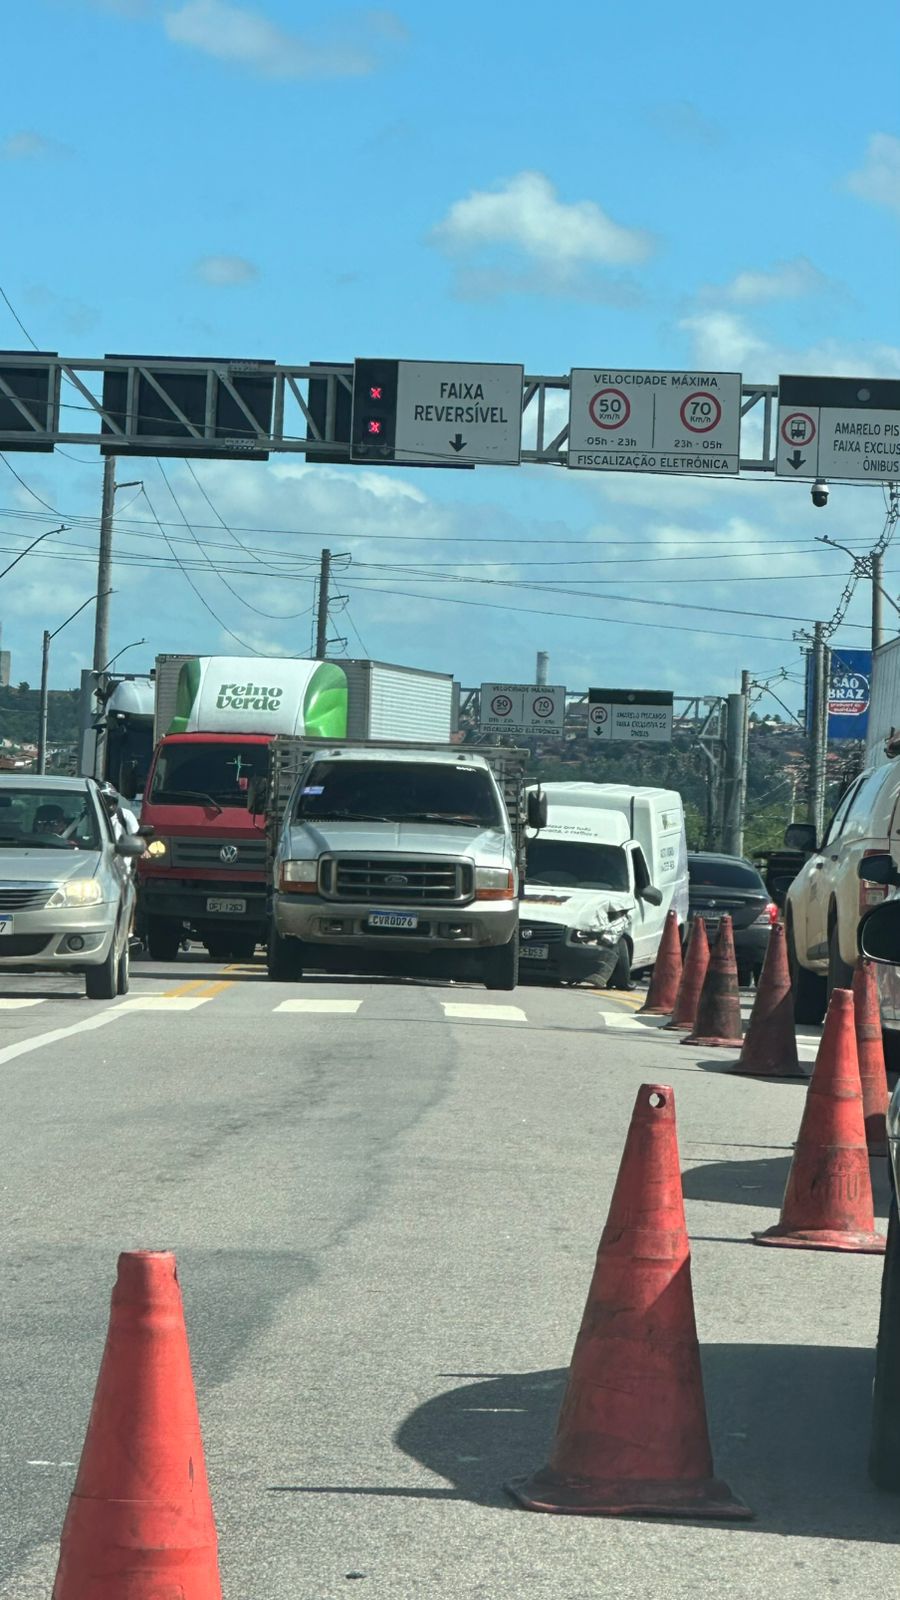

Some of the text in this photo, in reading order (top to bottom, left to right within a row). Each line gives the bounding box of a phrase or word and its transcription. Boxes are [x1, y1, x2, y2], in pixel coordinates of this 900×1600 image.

[593, 374, 718, 387] VELOCIDADE MÁXIMA
[439, 382, 484, 401] FAIXA
[413, 402, 508, 424] REVERSÍVEL
[599, 399, 622, 413] 50
[690, 401, 712, 416] 70
[690, 415, 711, 424] Km/h
[834, 422, 881, 436] AMARELO
[586, 436, 607, 447] 05h
[617, 437, 637, 447] 23h
[673, 439, 693, 449] 23h
[702, 440, 722, 450] 05h
[833, 439, 861, 453] FAIXA
[577, 454, 729, 470] FISCALIZAÇÃO ELETRÔNICA
[862, 455, 899, 473] ÔNIBUS
[828, 688, 865, 699] BRAZ
